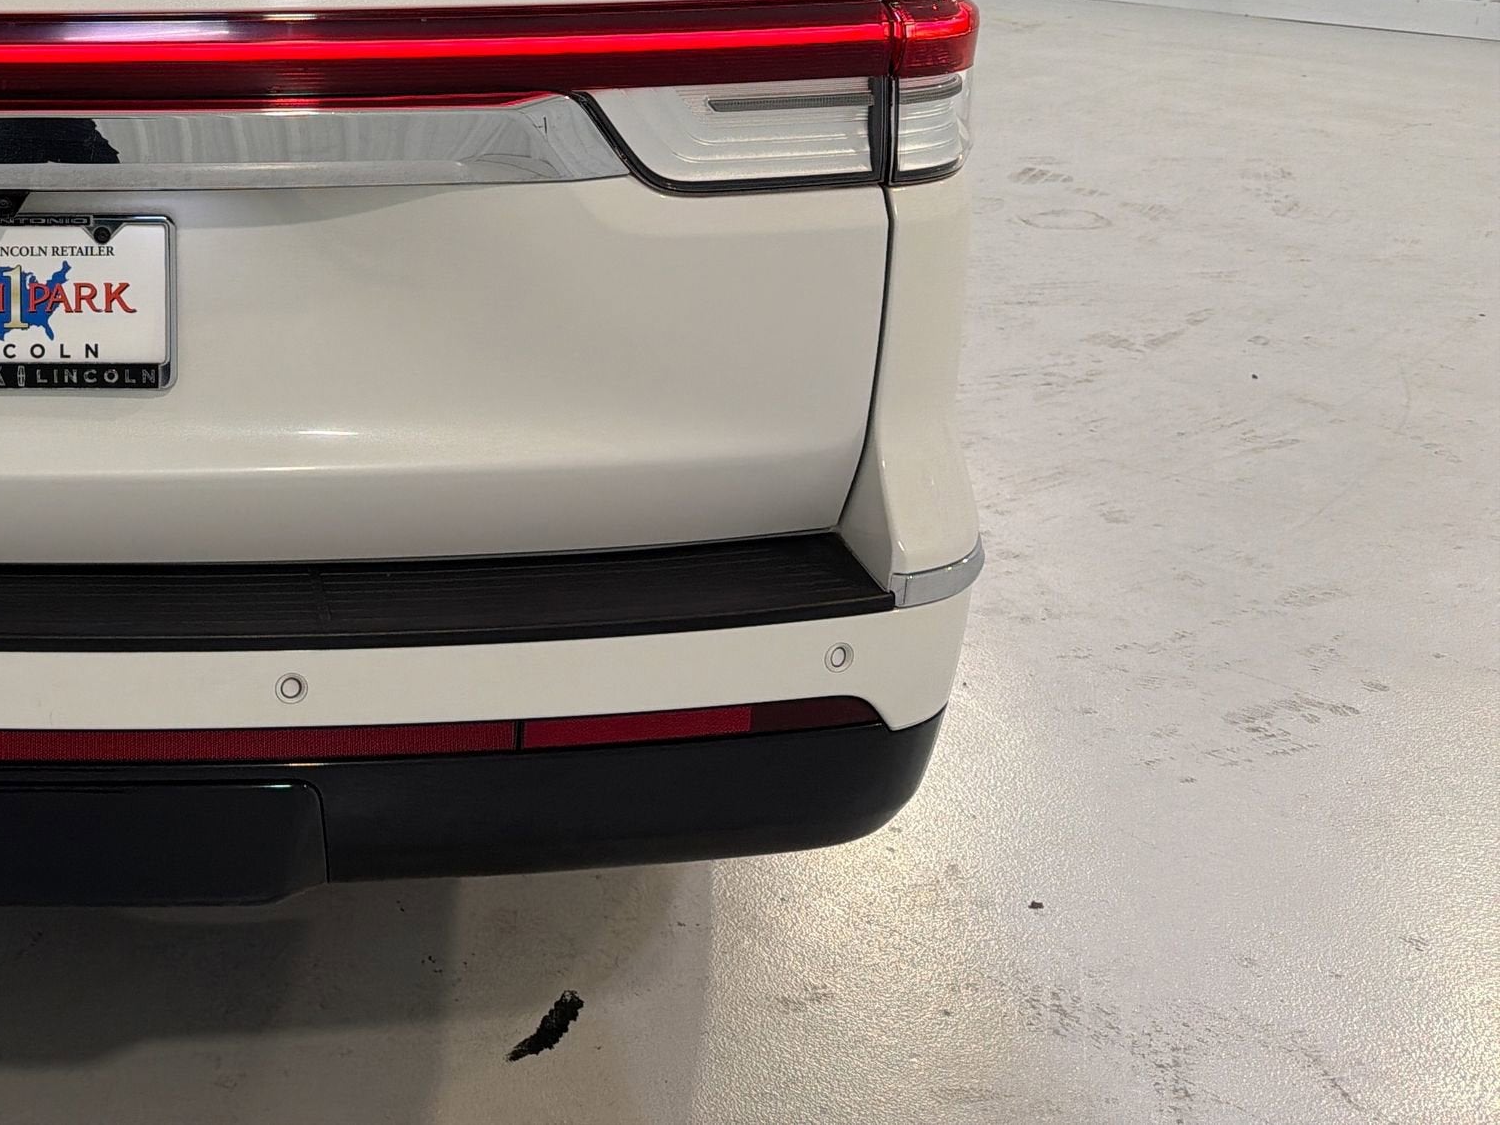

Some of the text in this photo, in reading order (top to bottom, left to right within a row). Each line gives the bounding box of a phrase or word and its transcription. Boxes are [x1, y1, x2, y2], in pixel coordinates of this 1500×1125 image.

[51, 245, 116, 257] RETAILER
[28, 282, 138, 315] PARK
[36, 368, 156, 384] LINCOLN
